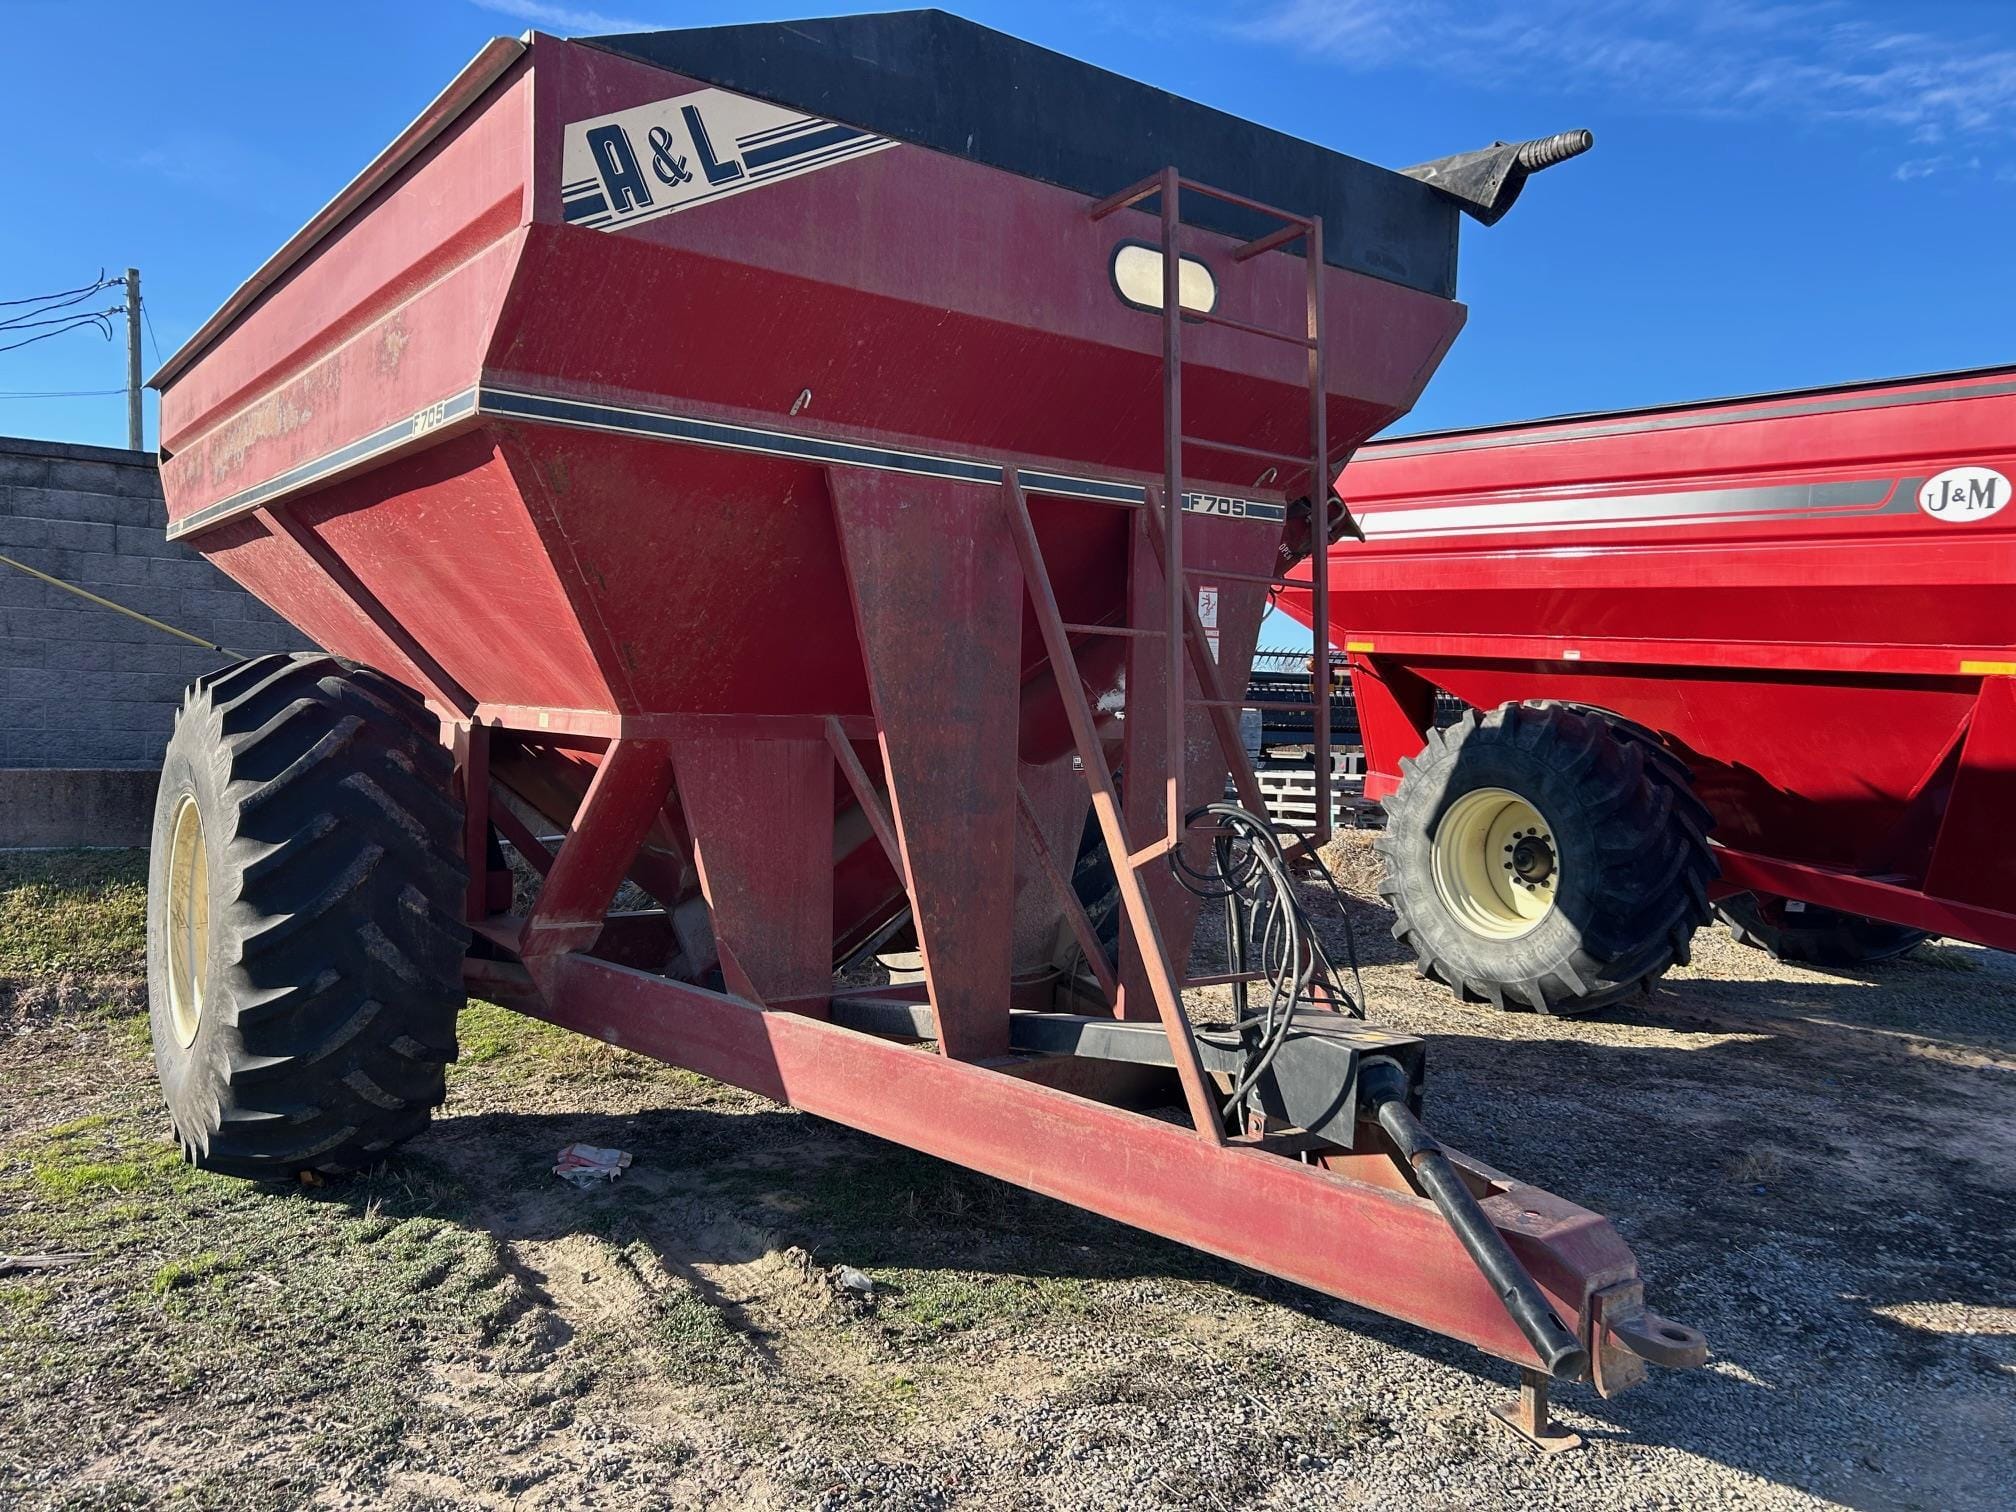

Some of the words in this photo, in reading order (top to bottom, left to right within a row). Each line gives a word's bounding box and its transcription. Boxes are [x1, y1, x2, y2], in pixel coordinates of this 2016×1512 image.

[586, 104, 745, 214] A&L
[413, 402, 444, 436] F705
[1190, 493, 1245, 517] F705
[1926, 477, 1999, 512] J&M
[1278, 543, 1293, 560] OPEN
